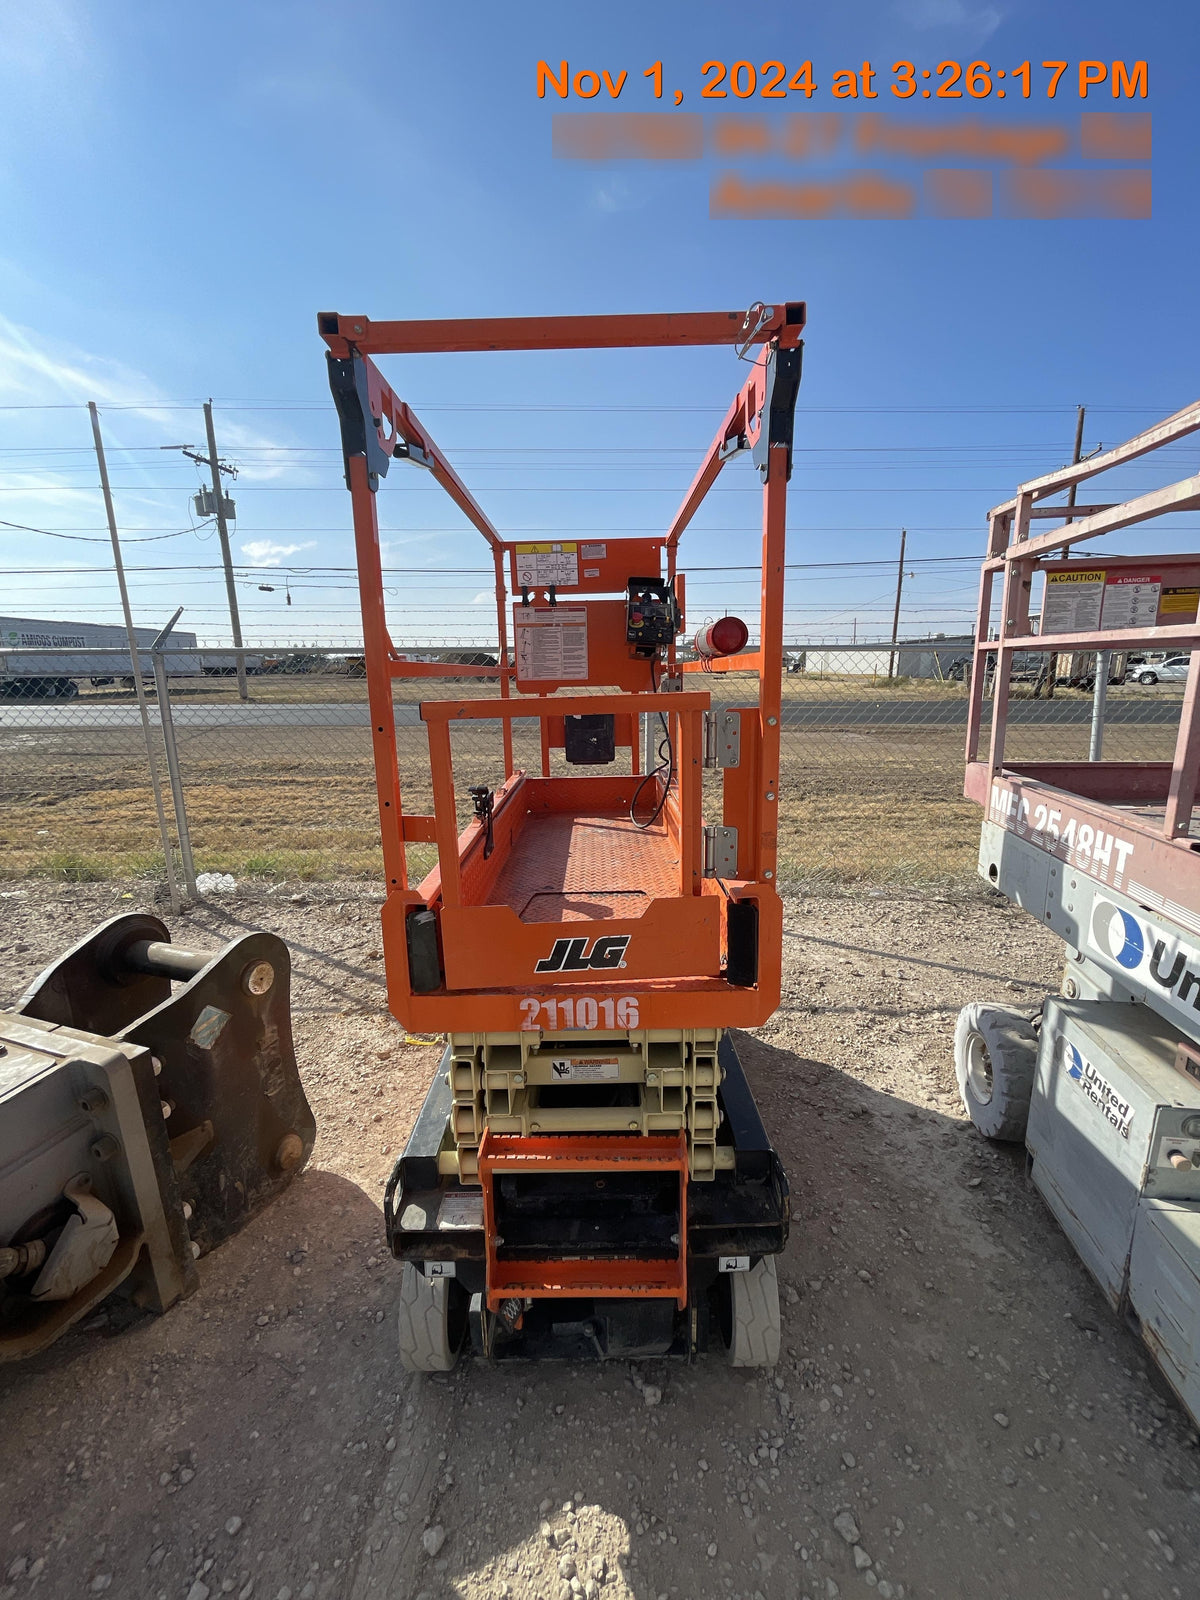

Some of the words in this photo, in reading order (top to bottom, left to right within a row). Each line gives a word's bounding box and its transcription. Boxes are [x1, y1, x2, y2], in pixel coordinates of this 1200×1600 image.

[1059, 573, 1102, 582] CAUTION
[21, 633, 52, 647] AMIGOS
[52, 635, 86, 648] COMPOST
[1030, 804, 1135, 889] 2548HT
[534, 934, 631, 974] JLG
[519, 996, 640, 1031] 211016
[1082, 1080, 1130, 1140] Rentals
[1085, 1062, 1130, 1119] United
